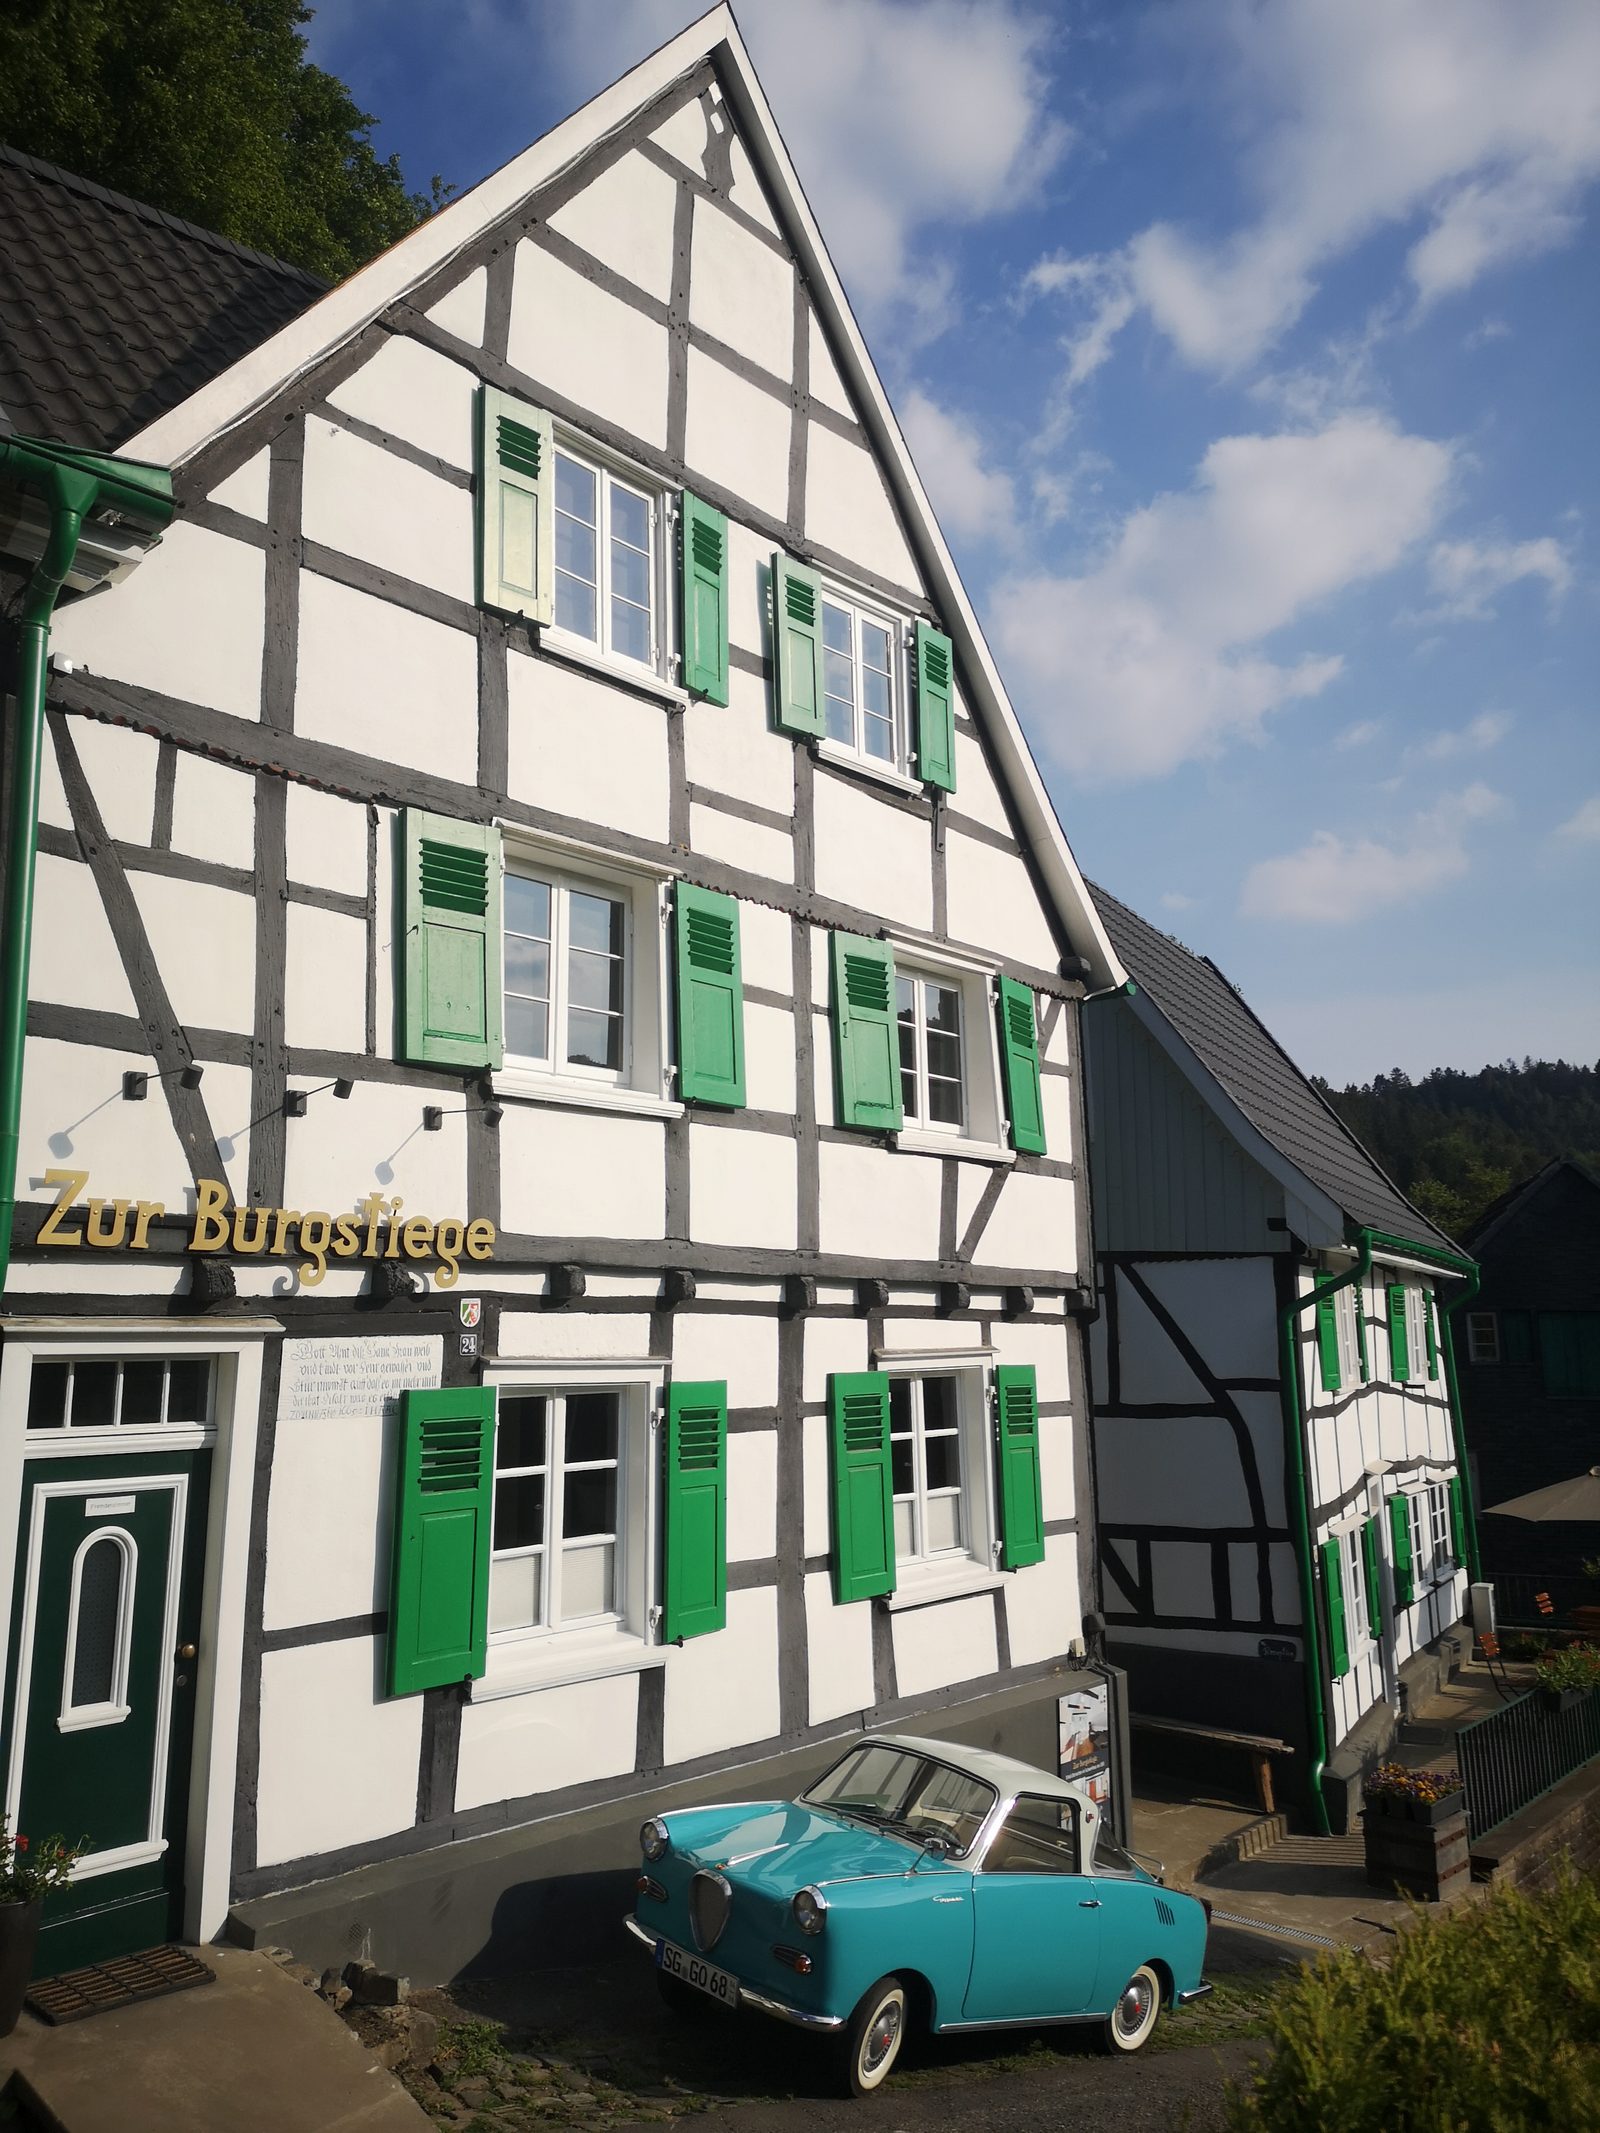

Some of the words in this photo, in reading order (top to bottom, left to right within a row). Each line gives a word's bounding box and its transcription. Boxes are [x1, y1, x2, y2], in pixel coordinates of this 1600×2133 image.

[37, 1168, 165, 1249] Zur
[188, 1179, 497, 1287] Burgstiege
[461, 1336, 475, 1353] 24
[663, 1947, 682, 1974] SG
[689, 1960, 707, 1987] GO
[710, 1971, 727, 1998] 68
